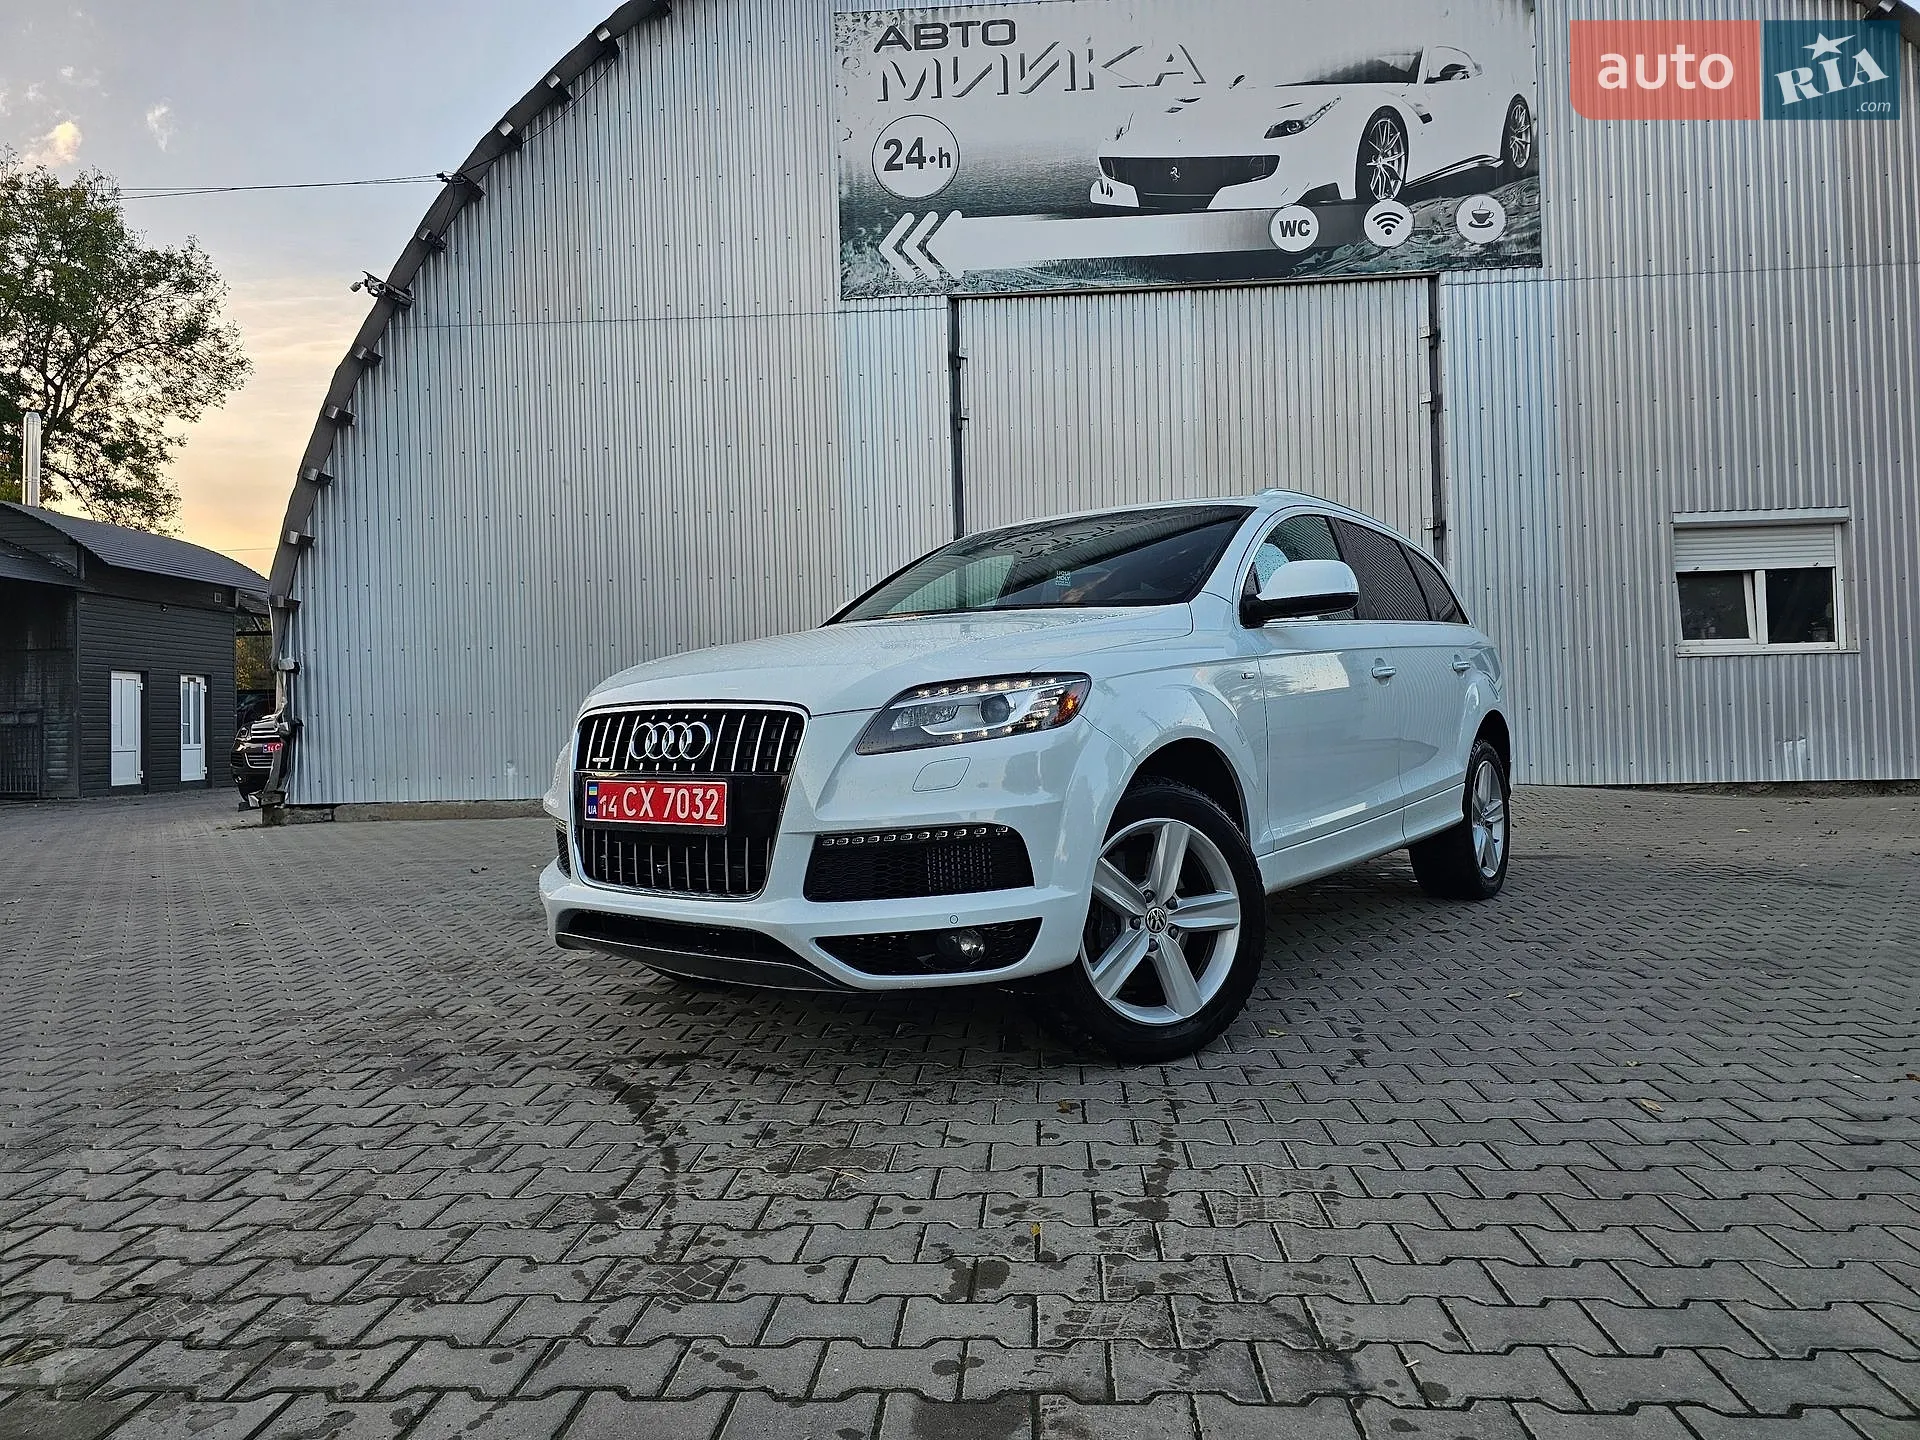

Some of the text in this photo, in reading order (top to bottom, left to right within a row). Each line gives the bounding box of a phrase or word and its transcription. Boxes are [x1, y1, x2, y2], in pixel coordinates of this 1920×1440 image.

[873, 19, 1016, 53] АВТО
[1279, 219, 1311, 238] WC
[588, 804, 597, 815] UA
[599, 786, 719, 820] 14 CX 7032
